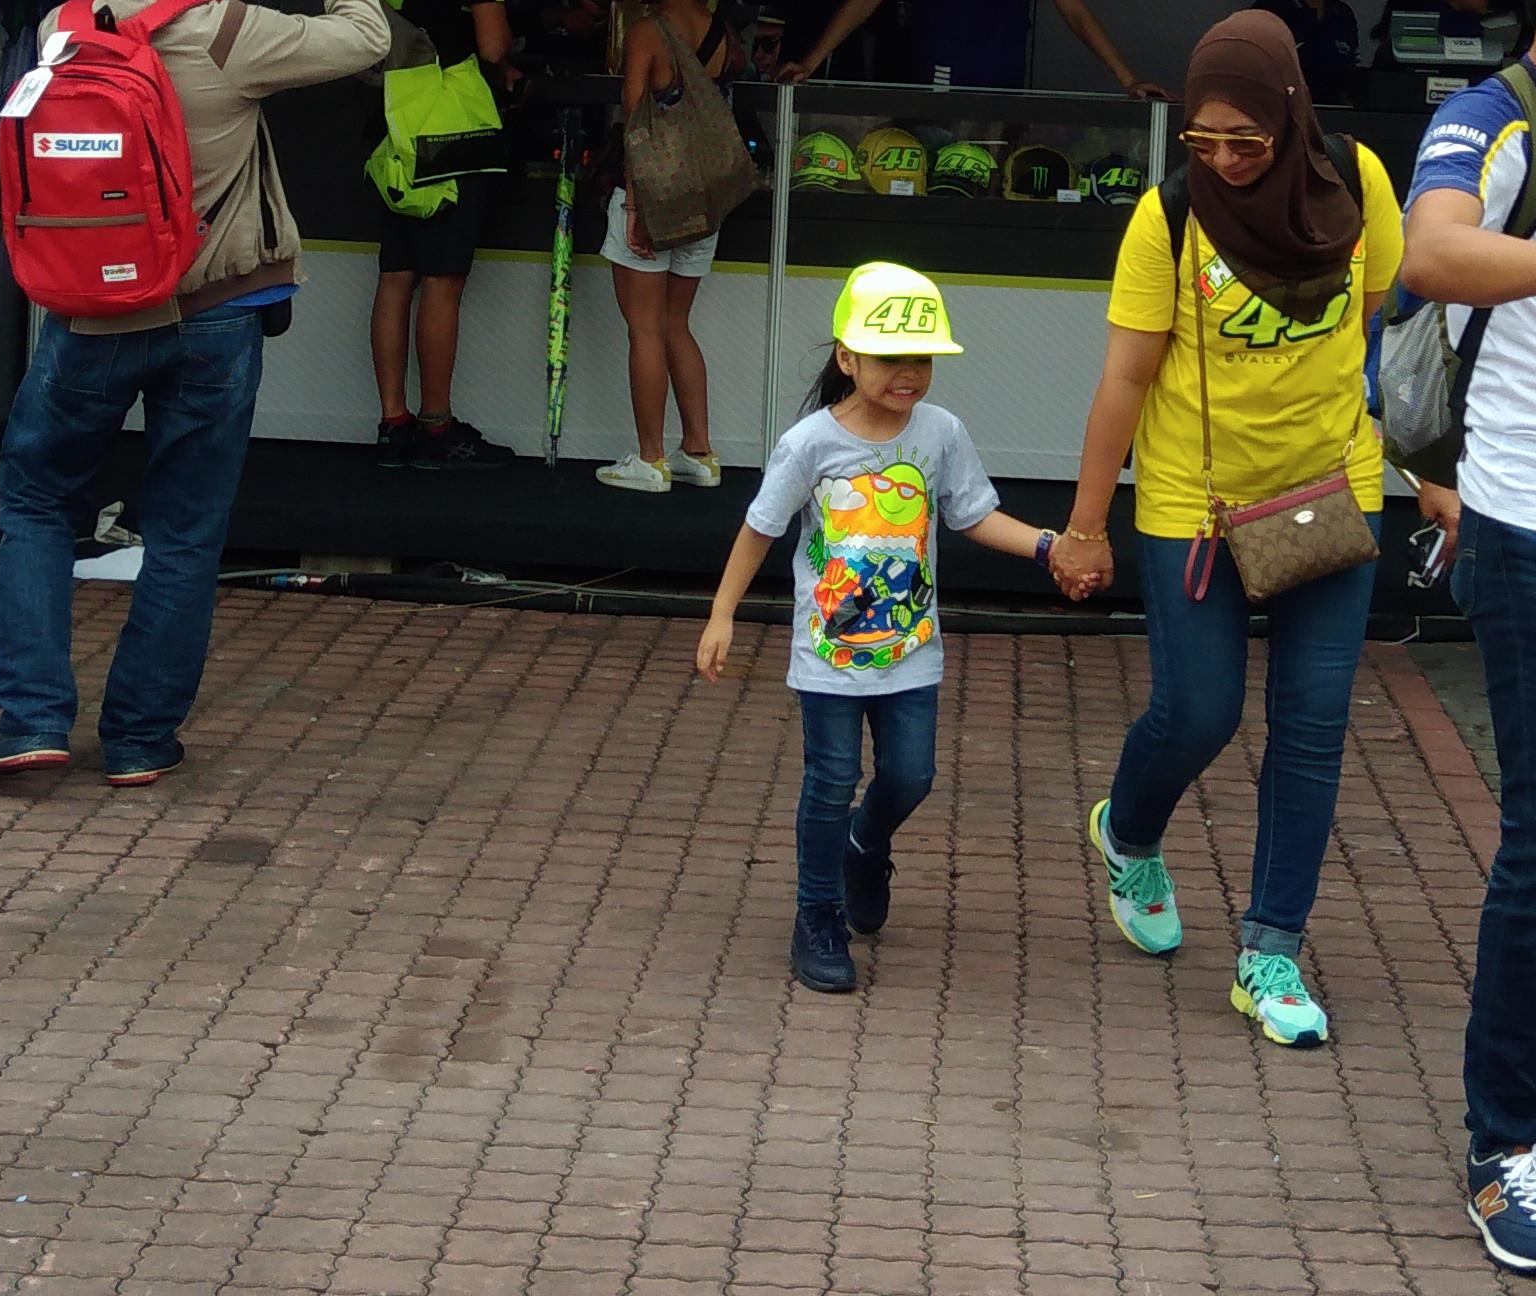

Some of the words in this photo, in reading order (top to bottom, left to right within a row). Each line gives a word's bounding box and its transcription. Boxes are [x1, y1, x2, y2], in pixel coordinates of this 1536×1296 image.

[55, 139, 119, 152] SUZUKI
[872, 146, 923, 171] 46
[1096, 166, 1141, 188] 46
[864, 297, 938, 334] 46
